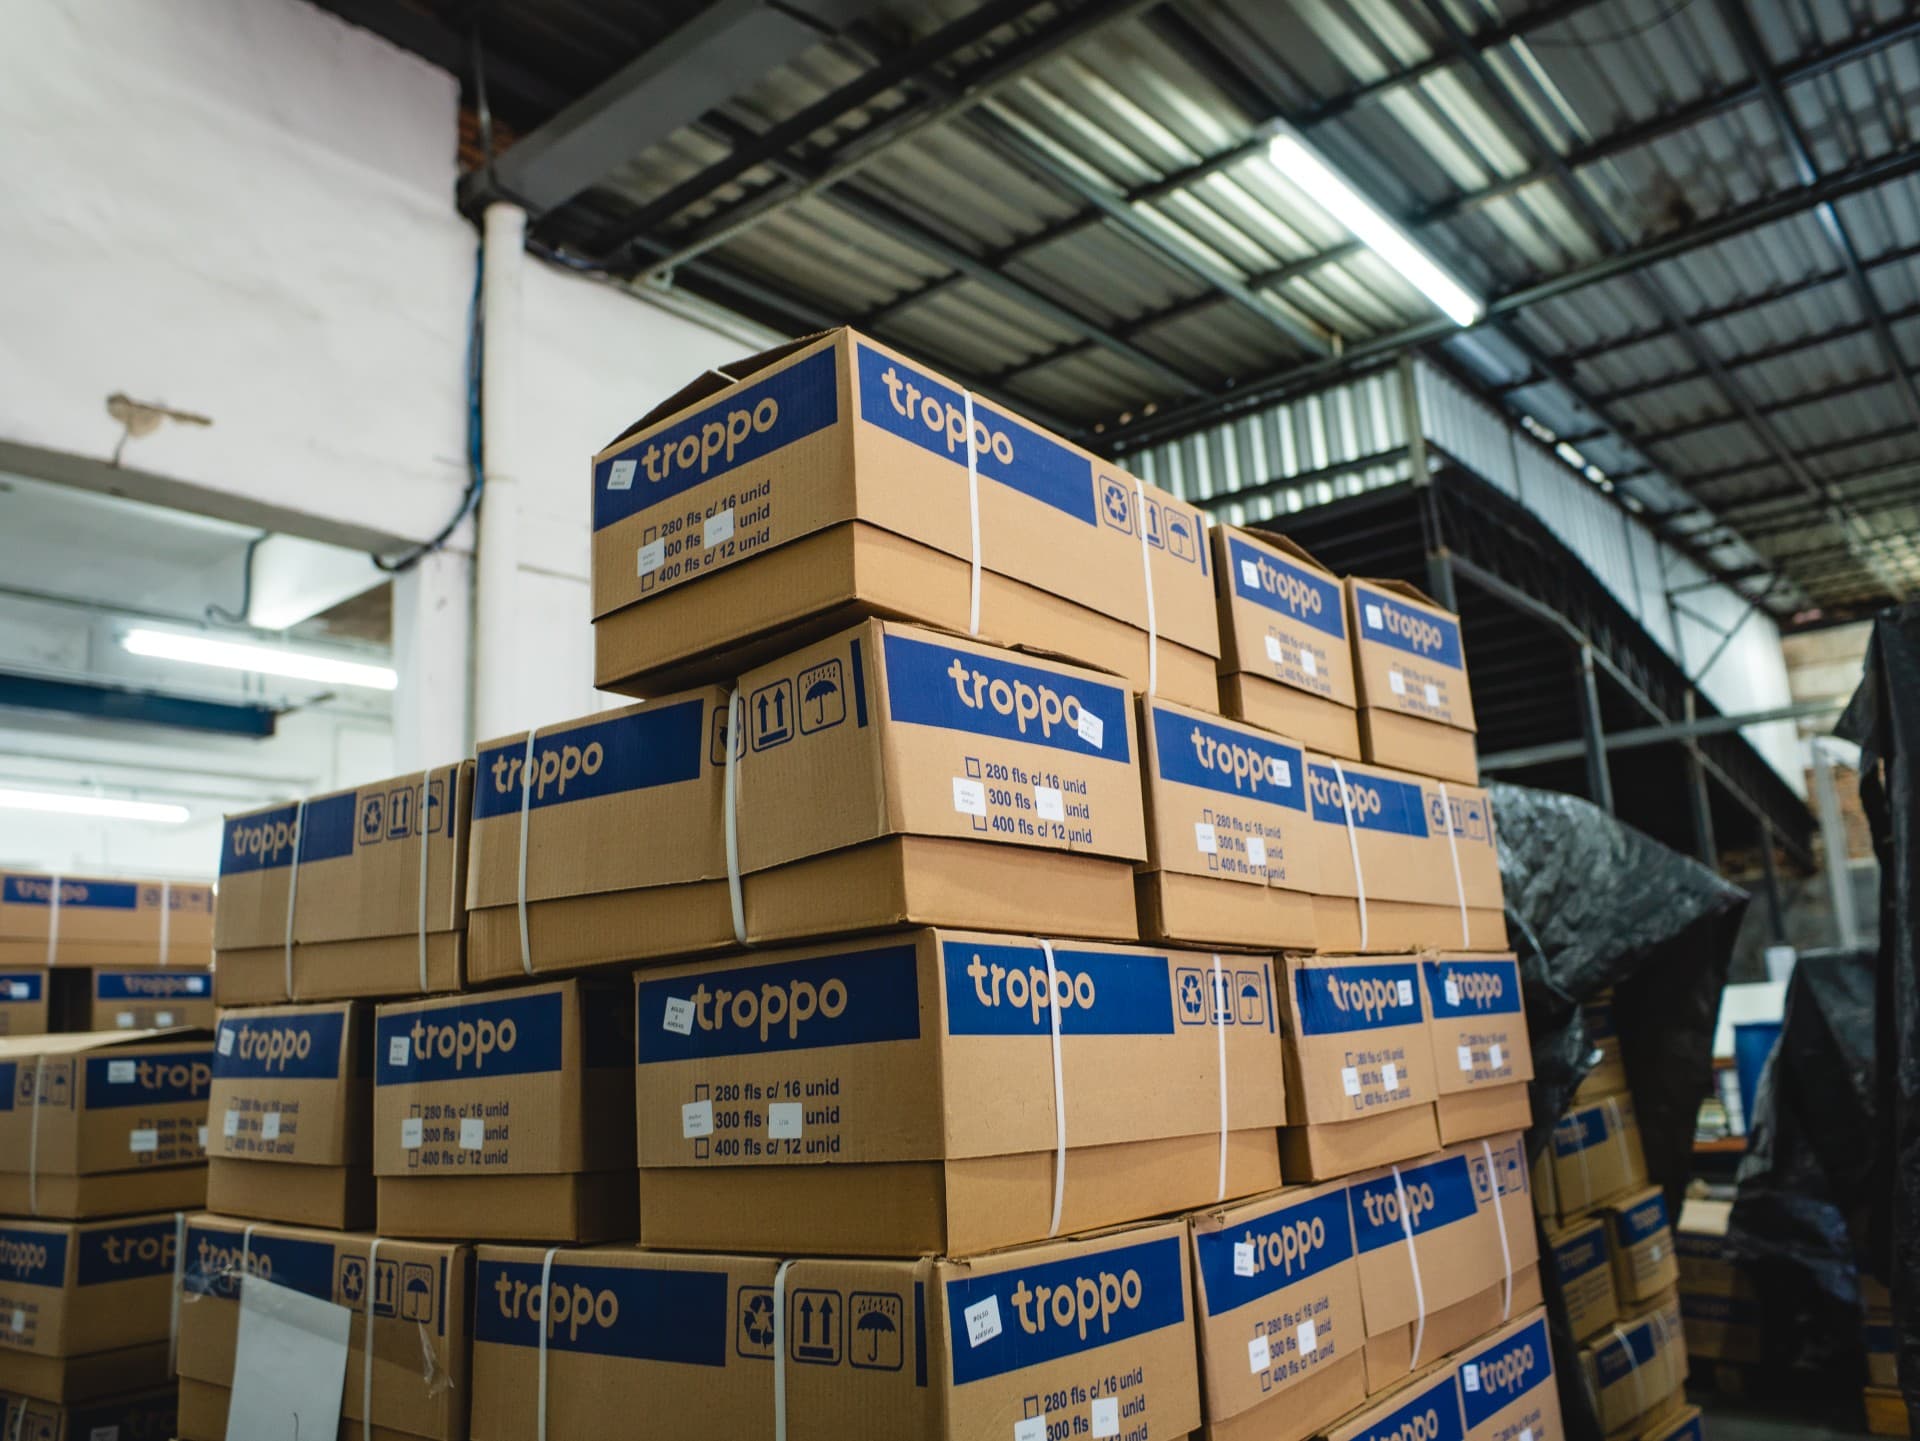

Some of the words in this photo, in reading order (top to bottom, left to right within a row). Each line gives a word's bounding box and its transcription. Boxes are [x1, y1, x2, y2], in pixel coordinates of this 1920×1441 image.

[642, 397, 778, 482] troppo
[881, 367, 1014, 465] troppo
[661, 517, 683, 538] 280
[686, 512, 702, 528] fls
[721, 495, 736, 511] 16
[740, 480, 771, 504] unid
[685, 533, 701, 551] fls
[740, 504, 771, 529] unid
[658, 563, 681, 584] 400
[684, 555, 700, 572] fls
[703, 545, 716, 565] c/
[719, 540, 735, 558] 12
[739, 528, 770, 552] unid
[1257, 556, 1322, 618] troppo
[1382, 602, 1442, 653] troppo
[948, 658, 1081, 738] troppo
[491, 742, 603, 800] troppo
[985, 763, 1009, 781] 280
[1012, 767, 1028, 785] fls
[1031, 771, 1042, 787] c/
[1046, 773, 1060, 790] 16
[1063, 778, 1087, 795] unid
[1190, 726, 1275, 793] troppo
[988, 788, 1012, 807] 300
[1015, 792, 1031, 810] fls
[1066, 803, 1090, 820] unid
[992, 815, 1015, 833] 400
[1018, 819, 1034, 836] fls
[1038, 821, 1048, 837] c/
[1052, 823, 1065, 840] 12
[1068, 828, 1093, 844] unid
[690, 978, 848, 1043] troppo
[967, 953, 1095, 1025] troppo
[1327, 974, 1398, 1022] troppo
[239, 1024, 312, 1072] troppo
[410, 1018, 517, 1071] troppo
[136, 1060, 212, 1095] trop
[715, 1084, 740, 1101] 280
[744, 1083, 761, 1100] fls
[766, 1082, 779, 1099] c/
[784, 1080, 801, 1098] 16
[805, 1078, 840, 1097] unid
[424, 1105, 441, 1120] 280
[485, 1102, 509, 1117] unid
[484, 1124, 509, 1140] unid
[715, 1111, 740, 1129] 300
[744, 1110, 761, 1128] fls
[805, 1106, 840, 1125] unid
[422, 1151, 440, 1166] 400
[484, 1149, 509, 1165] unid
[714, 1139, 740, 1157] 400
[744, 1137, 761, 1156] fls
[766, 1138, 779, 1155] c/
[784, 1138, 801, 1155] 12
[805, 1135, 841, 1154] unid
[494, 1272, 619, 1342] troppo
[1011, 1268, 1143, 1341] troppo
[1044, 1390, 1068, 1413] 280
[1071, 1385, 1087, 1405] fls
[1090, 1379, 1101, 1399] c/
[1104, 1375, 1117, 1395] 16
[1120, 1365, 1144, 1390] unid
[1480, 1344, 1534, 1394] troppo
[1046, 1419, 1070, 1441] 300
[1073, 1415, 1089, 1436] fls
[1122, 1394, 1146, 1418] unid
